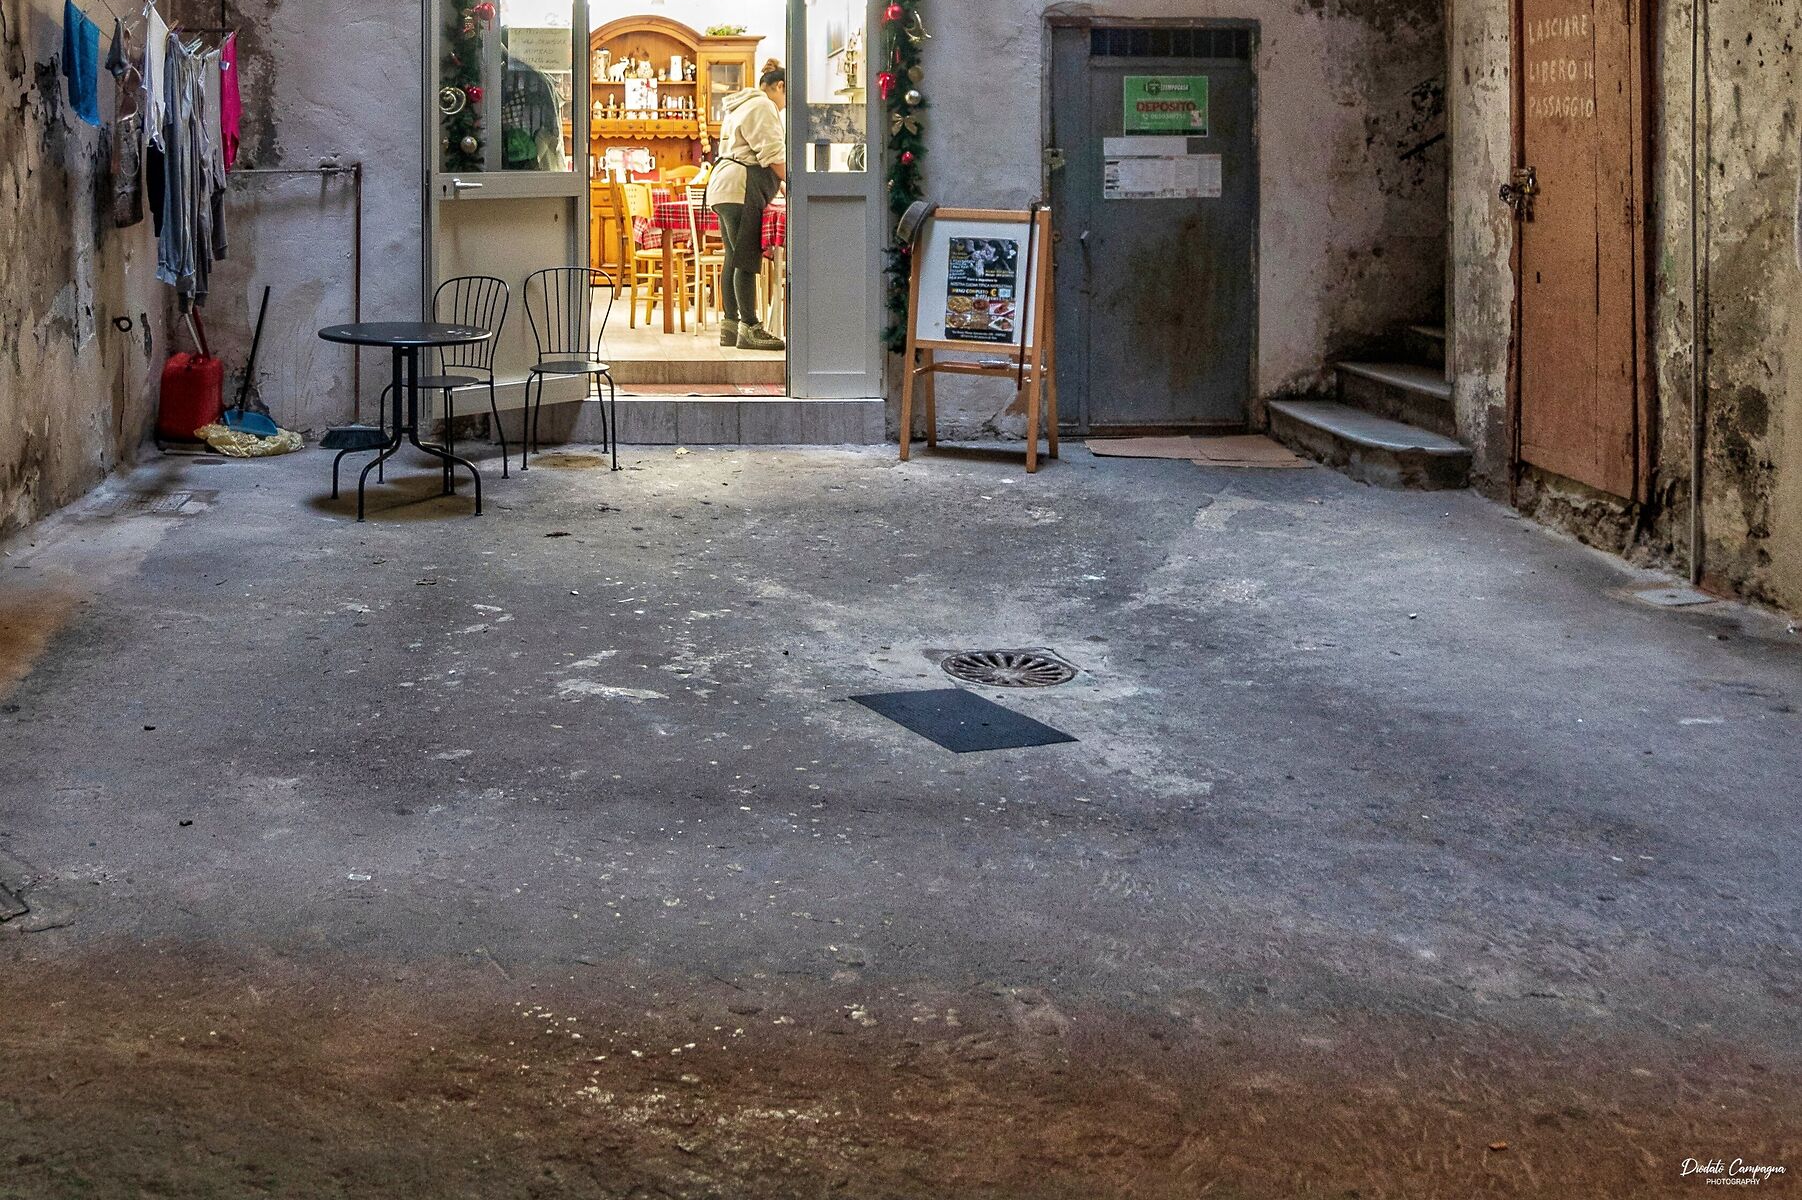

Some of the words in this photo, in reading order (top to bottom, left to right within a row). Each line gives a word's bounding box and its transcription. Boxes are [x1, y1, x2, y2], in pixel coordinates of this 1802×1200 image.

[1528, 14, 1588, 44] LASCIARE
[1529, 59, 1577, 85] LIBERO
[1584, 61, 1594, 81] IL
[1136, 101, 1197, 113] DEPOSITO
[1529, 95, 1594, 119] PASSAGGIO
